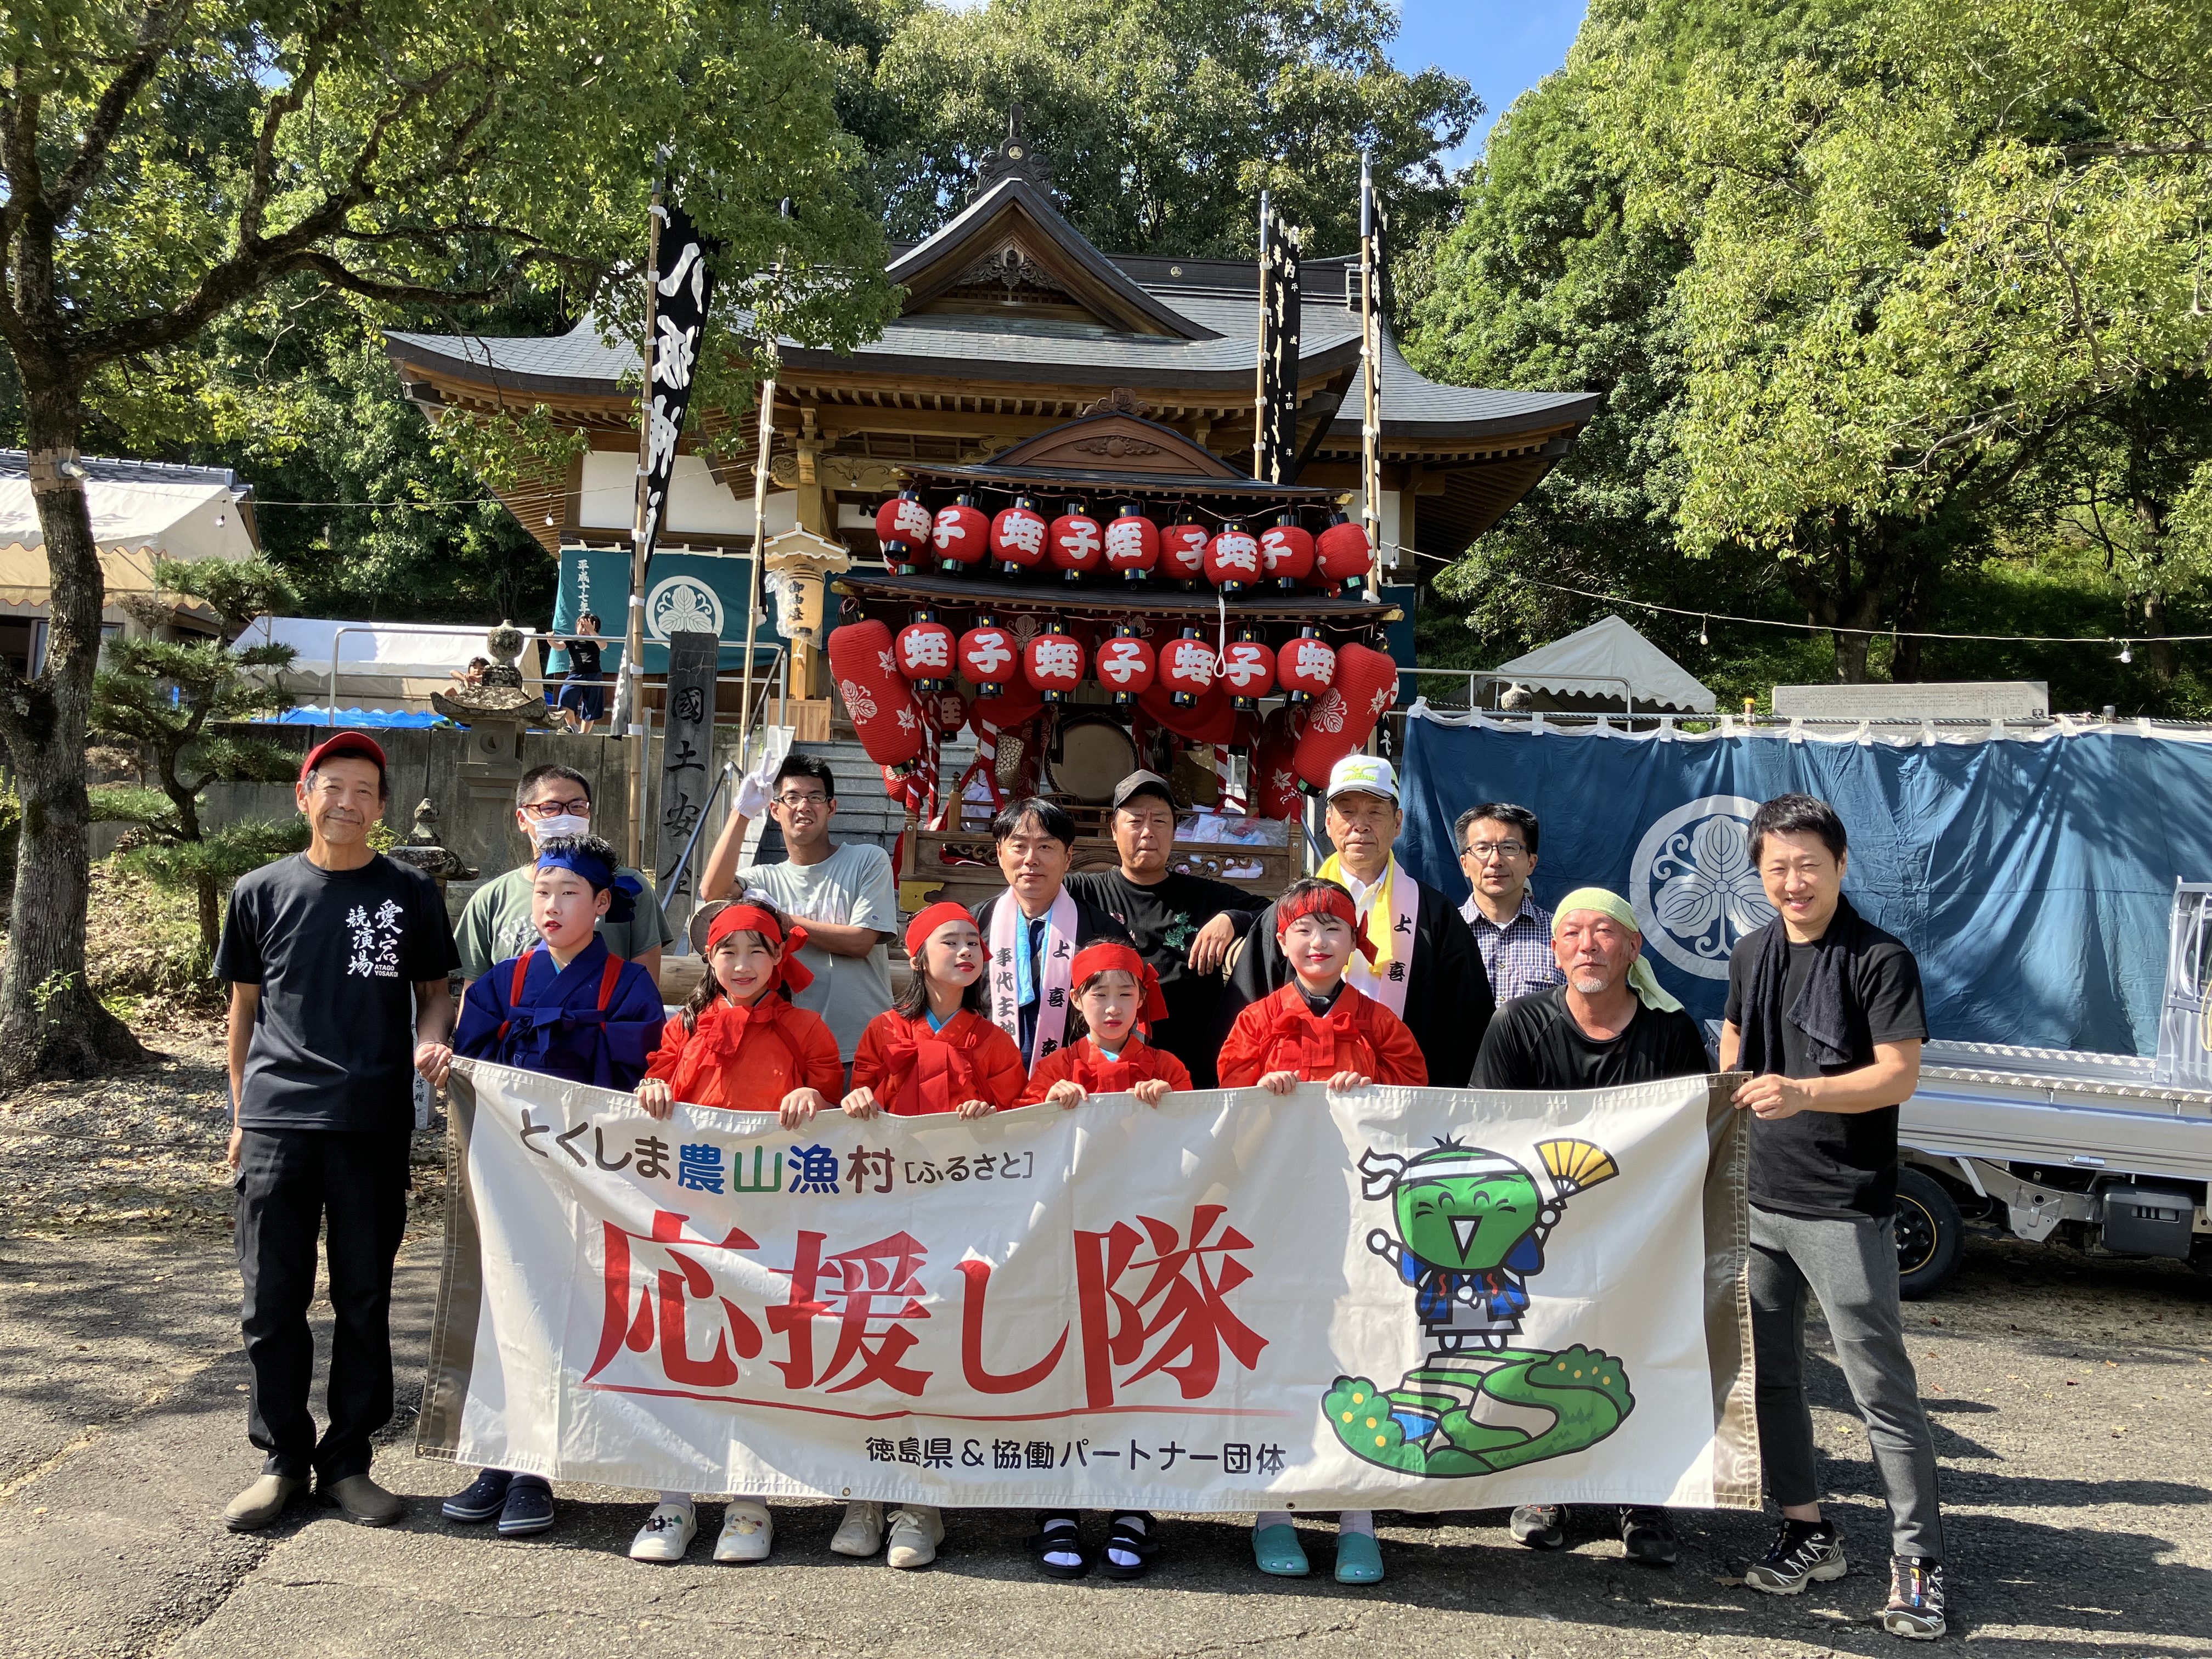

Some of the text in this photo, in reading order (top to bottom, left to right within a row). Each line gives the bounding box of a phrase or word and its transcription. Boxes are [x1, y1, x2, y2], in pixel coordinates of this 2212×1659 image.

[1060, 521, 1100, 560] 子
[904, 629, 948, 669] 蛭
[968, 633, 1012, 673] 子
[1035, 640, 1079, 679] 蛭
[1103, 642, 1147, 683] 子
[1225, 646, 1266, 687] 子
[346, 905, 375, 978] 競演場
[375, 899, 403, 964] 愛宕
[583, 1204, 1269, 1408] 応援し隊
